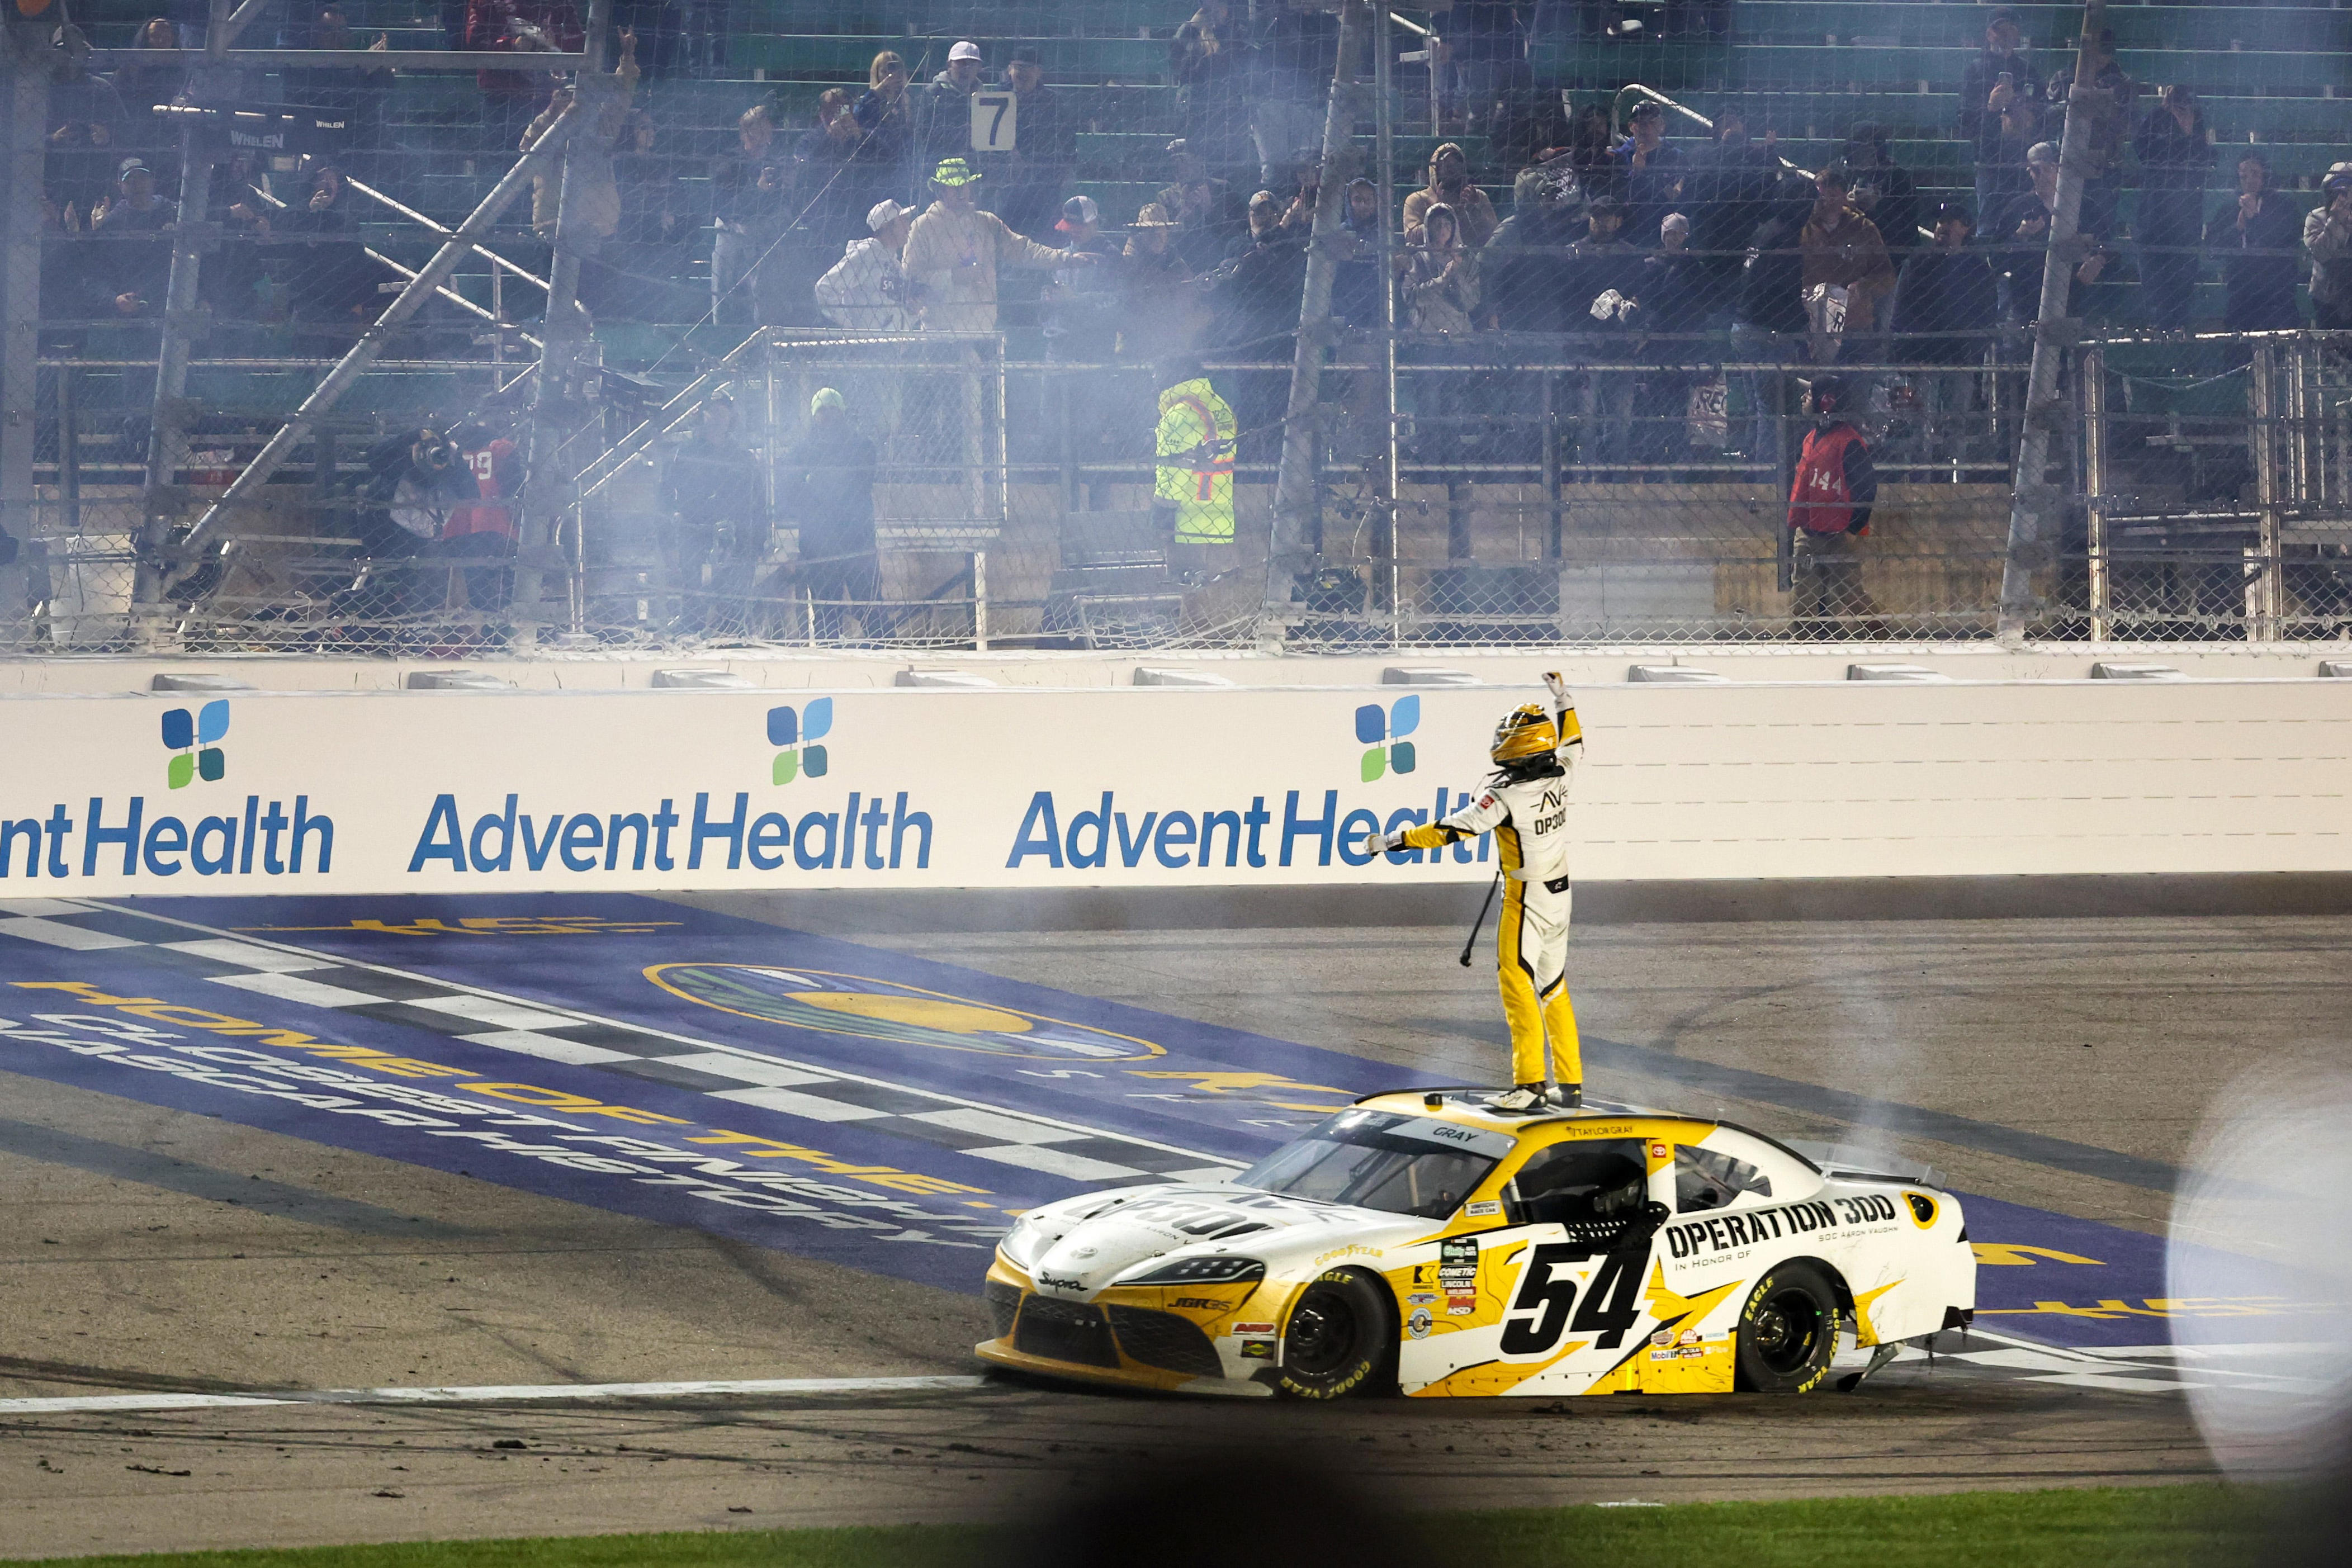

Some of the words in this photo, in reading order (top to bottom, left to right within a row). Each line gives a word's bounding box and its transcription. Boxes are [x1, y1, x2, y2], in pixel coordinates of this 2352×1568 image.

[230, 130, 284, 148] WHELEN
[316, 120, 345, 129] WHELEN
[979, 97, 1009, 146] 7
[0, 794, 334, 878] ntHealth
[407, 791, 933, 873] AdventHealth
[1005, 787, 1494, 869] AdventHealt
[6, 982, 483, 1077] HOME
[455, 1082, 695, 1125] OF
[683, 1129, 996, 1195] THE
[30, 1013, 598, 1133] CLOSEST
[551, 1134, 978, 1221] FINISH
[1432, 1126, 1480, 1143] GRAY
[1577, 1127, 1610, 1136] TAYLOR
[1610, 1125, 1634, 1135] GRAY
[424, 1130, 991, 1249] HISTORY
[1665, 1201, 1838, 1258] OPERATION
[1834, 1194, 1897, 1225] 300
[1738, 1250, 1752, 1258] OF
[1039, 1271, 1089, 1294] Supra
[1315, 1271, 1354, 1285] AGLE
[1500, 1237, 1652, 1355] 54
[1744, 1276, 1774, 1321] EAGLE
[1651, 1351, 1669, 1359] Mobil
